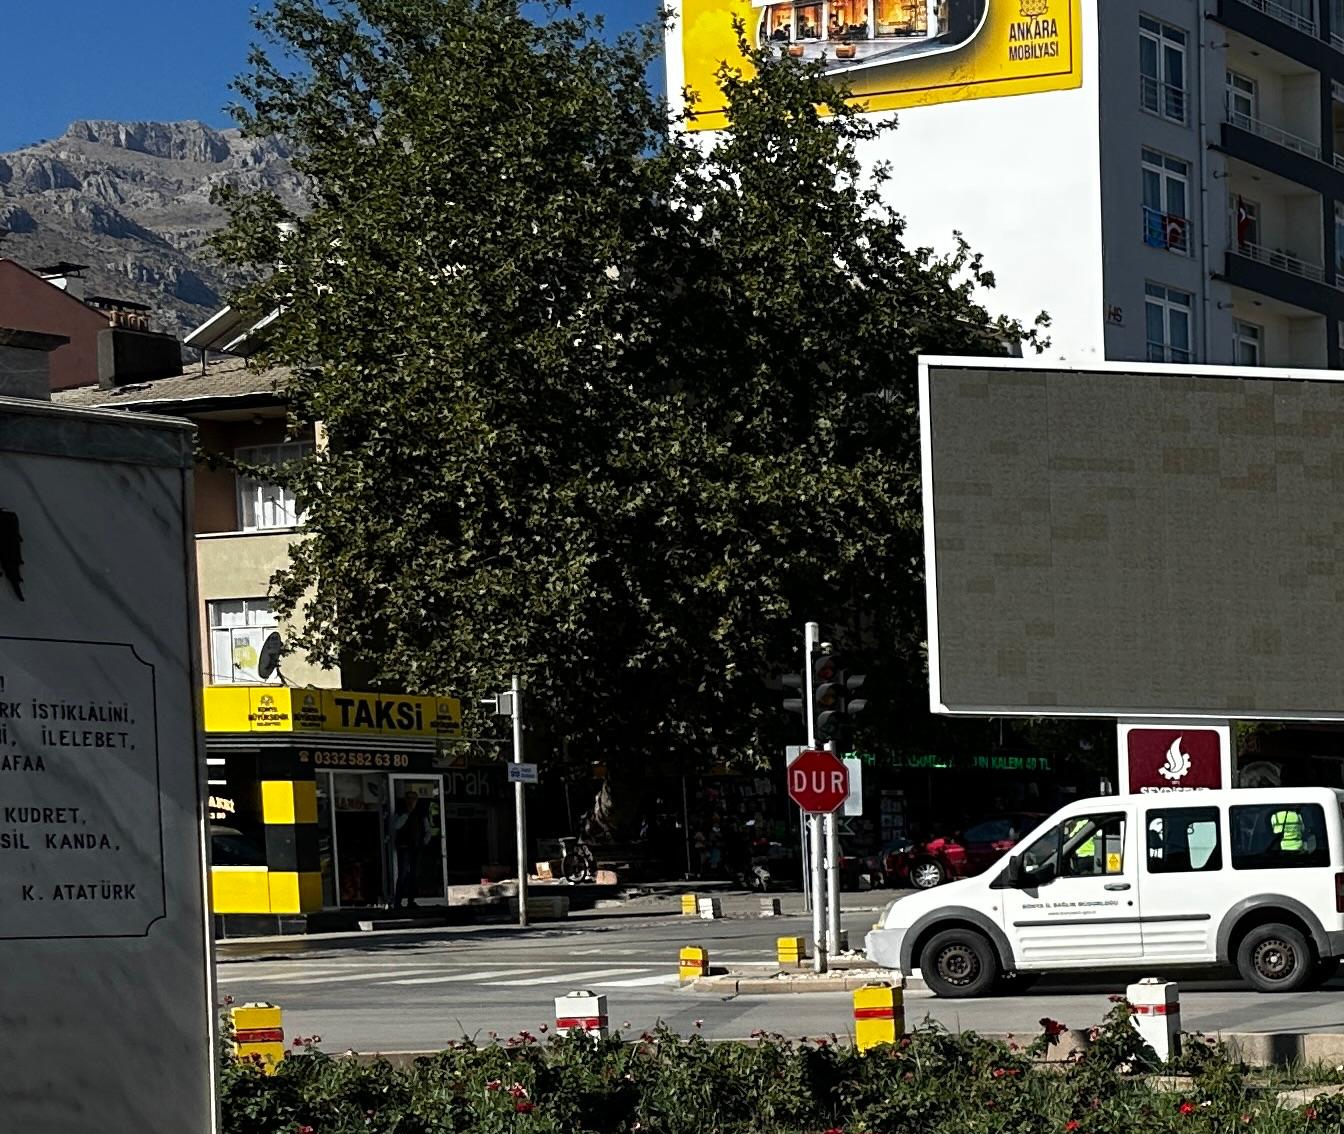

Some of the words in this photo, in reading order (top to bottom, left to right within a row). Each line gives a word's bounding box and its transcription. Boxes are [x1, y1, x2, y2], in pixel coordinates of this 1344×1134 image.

[1008, 18, 1058, 42] ANKARA
[1008, 41, 1059, 61] MOBİLYASI
[41, 725, 135, 750] İLELEBET,
[314, 751, 348, 765] 0332
[349, 752, 372, 766] 582
[375, 754, 391, 767] 63
[393, 755, 409, 767] 80
[793, 770, 844, 794] DUR
[22, 885, 44, 901] K.
[52, 880, 136, 900] ATATÜRK
